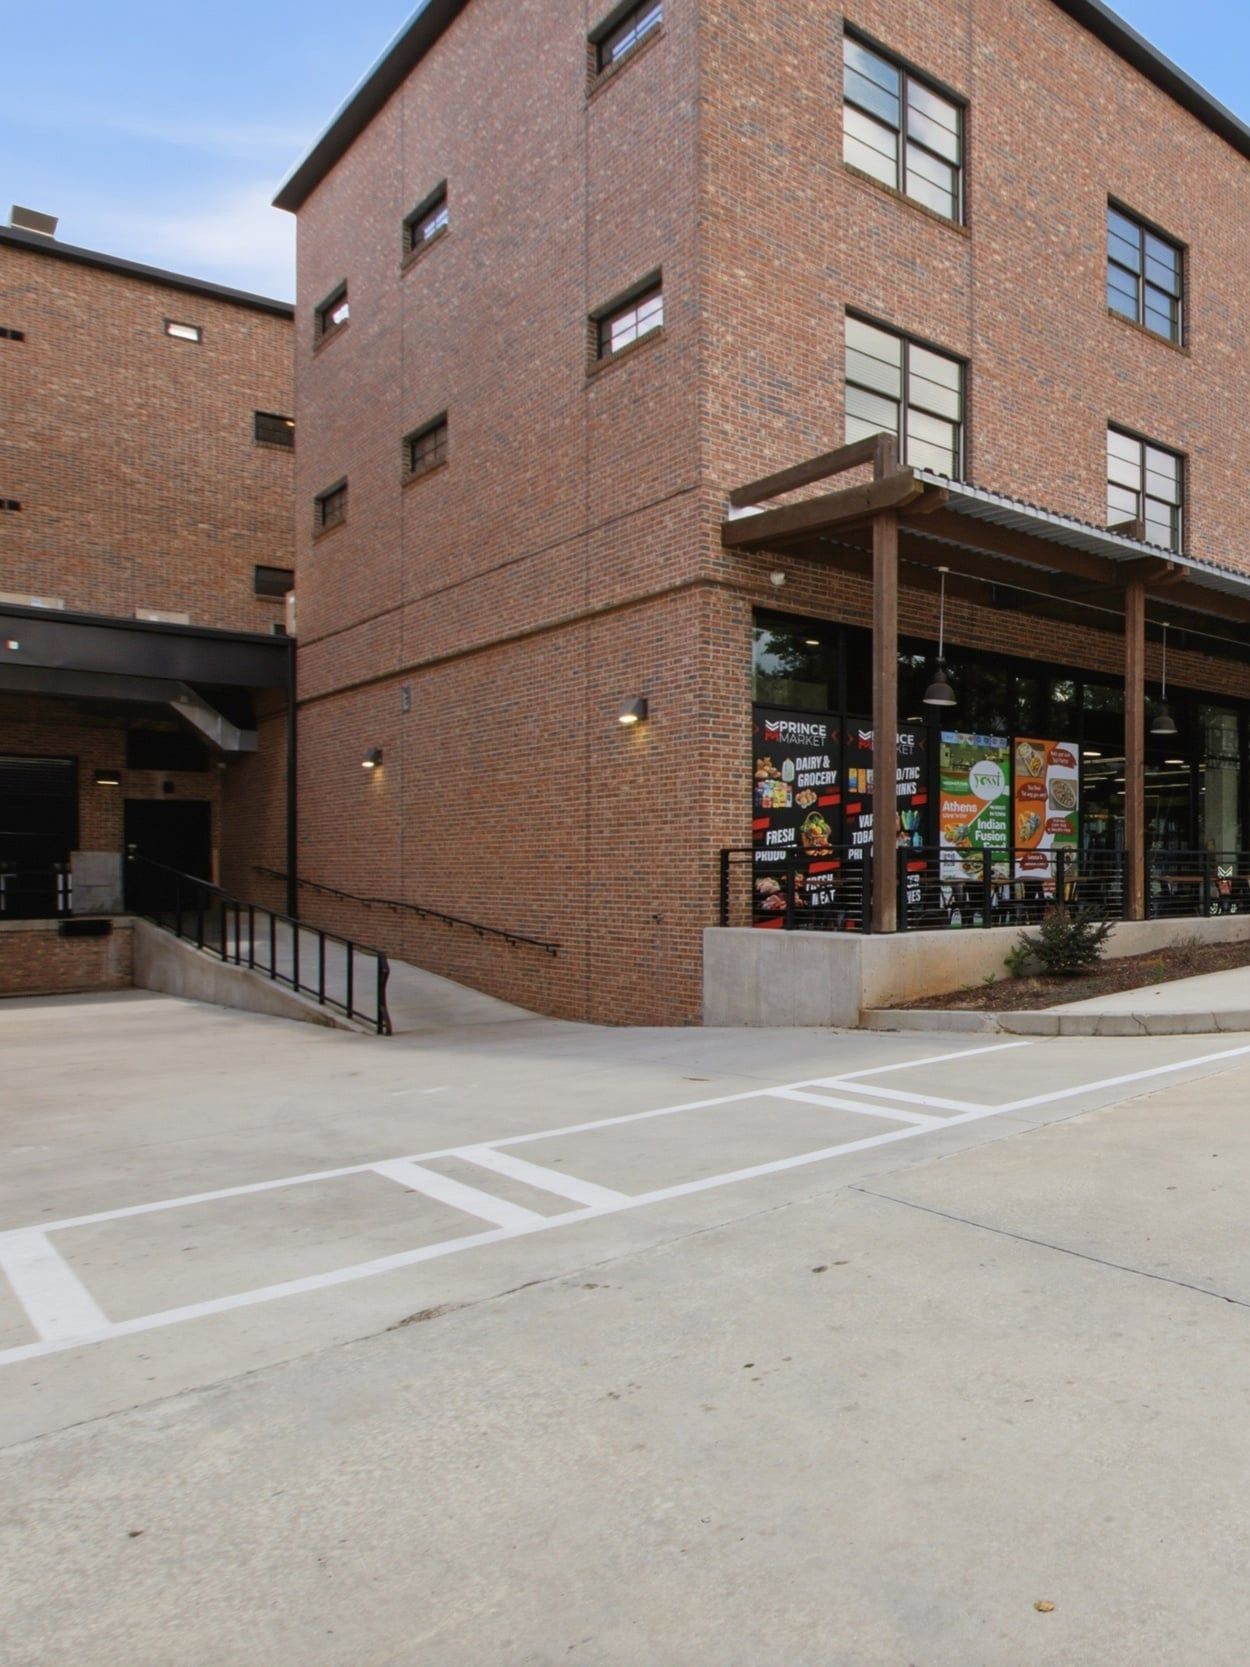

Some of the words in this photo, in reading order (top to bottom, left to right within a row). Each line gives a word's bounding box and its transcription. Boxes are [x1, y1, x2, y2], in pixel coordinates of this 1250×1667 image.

[779, 720, 827, 737] PRINCE
[779, 732, 826, 747] MARKET
[796, 756, 822, 771] DAIRY
[822, 755, 831, 768] &
[797, 770, 837, 787] GROCERY
[943, 801, 977, 812] Athens
[977, 818, 1006, 830] Indian
[766, 828, 795, 846] FRESH
[975, 830, 1006, 841] Fusion
